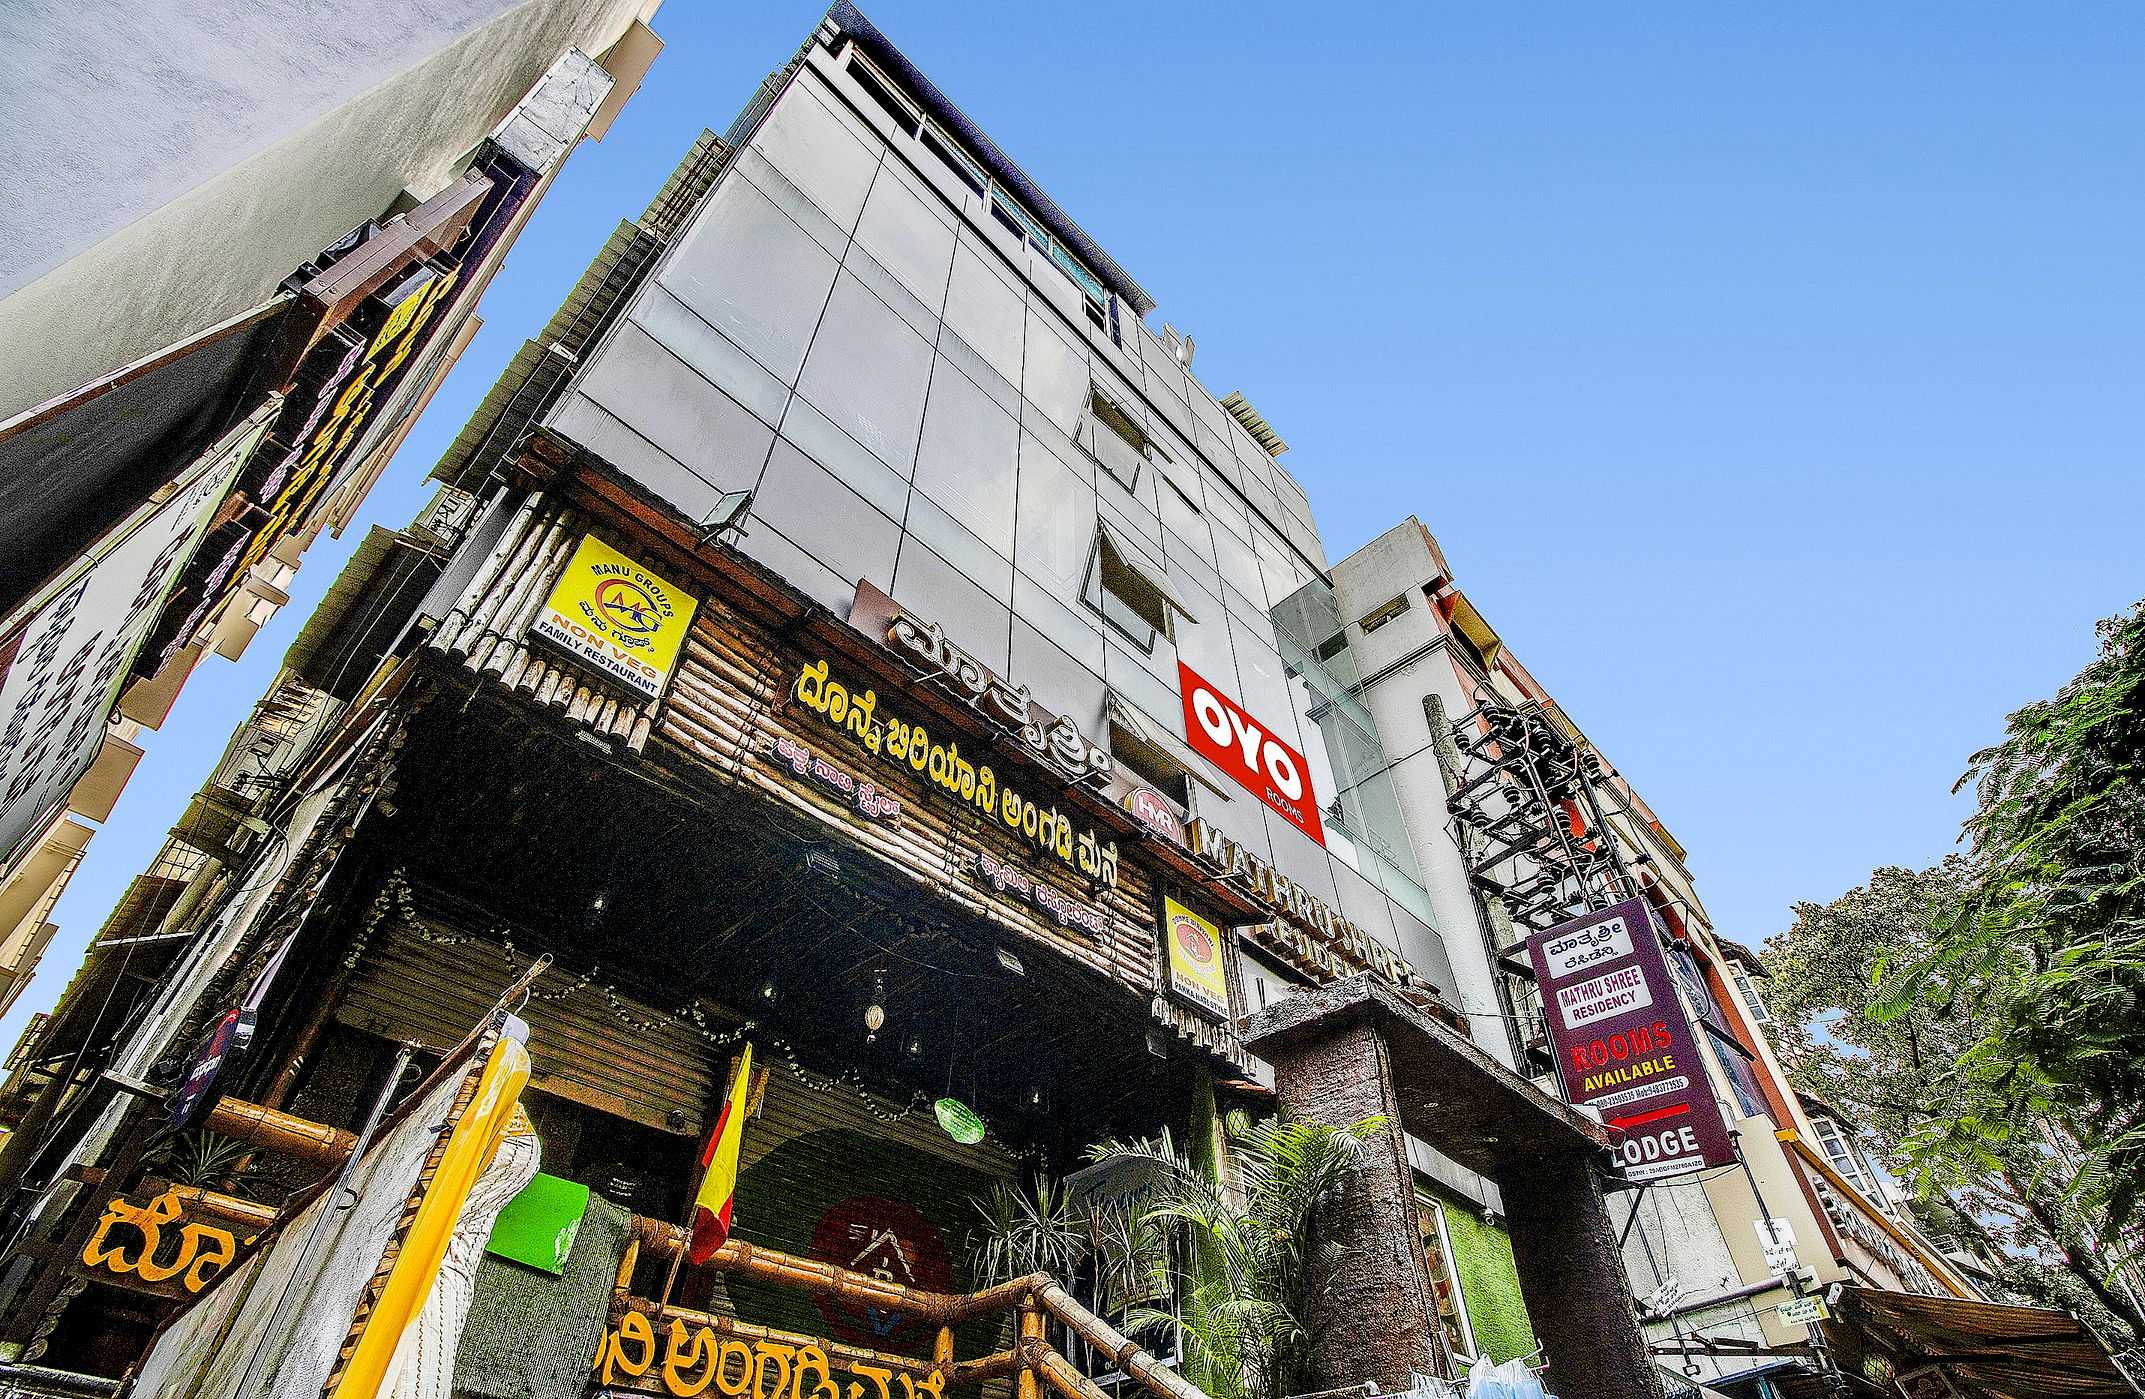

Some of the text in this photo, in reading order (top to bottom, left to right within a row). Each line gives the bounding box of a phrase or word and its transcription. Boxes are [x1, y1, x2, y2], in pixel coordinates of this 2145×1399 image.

[591, 563, 674, 618] MANU GROUPS
[539, 620, 658, 694] FAMILY RESTAURANT
[552, 614, 657, 680] NON VEG
[1192, 687, 1303, 801] OYO
[797, 659, 1119, 888] ದೊನ್ನೆ ಬಿರಿಯಾನಿ ಅಂಗಡಿ ಮನೆ
[1265, 786, 1305, 825] ROOMS
[1197, 815, 1336, 939] MATHRU
[1549, 922, 1622, 956] ಮಾತೃಶ್ರೀ
[1176, 971, 1225, 1005] NON VEG
[1560, 968, 1641, 1008] MATHRU SHREE
[1572, 990, 1637, 1021] RESIDENCY
[1570, 1020, 1673, 1073] ROOMS
[1584, 1055, 1676, 1092] AVAILABLE
